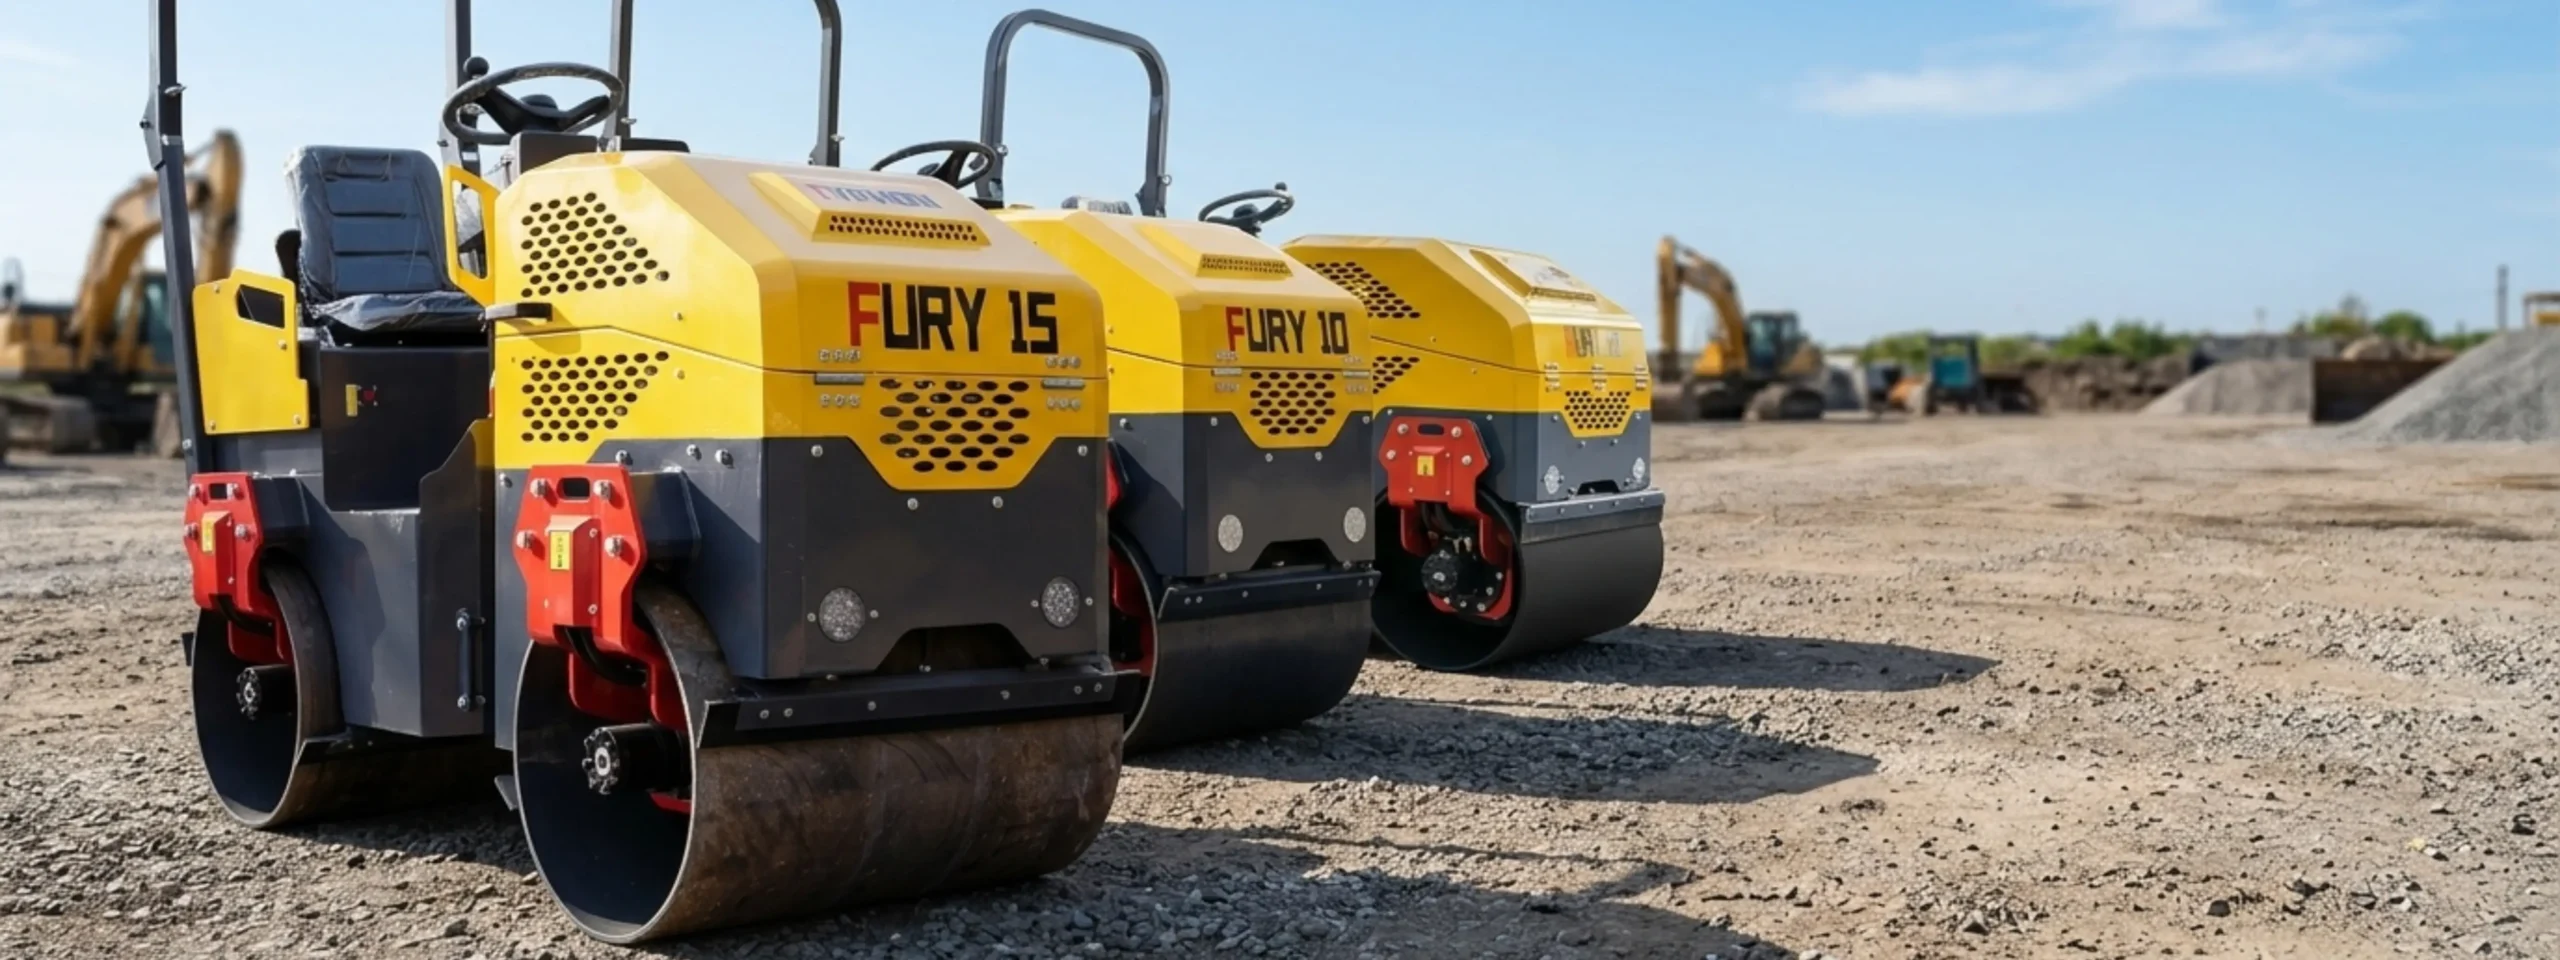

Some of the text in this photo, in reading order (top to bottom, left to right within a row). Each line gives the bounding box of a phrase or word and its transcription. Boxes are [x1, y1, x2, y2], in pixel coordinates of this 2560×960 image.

[848, 281, 1059, 354] FURY 15
[1225, 306, 1350, 355] FURY 10
